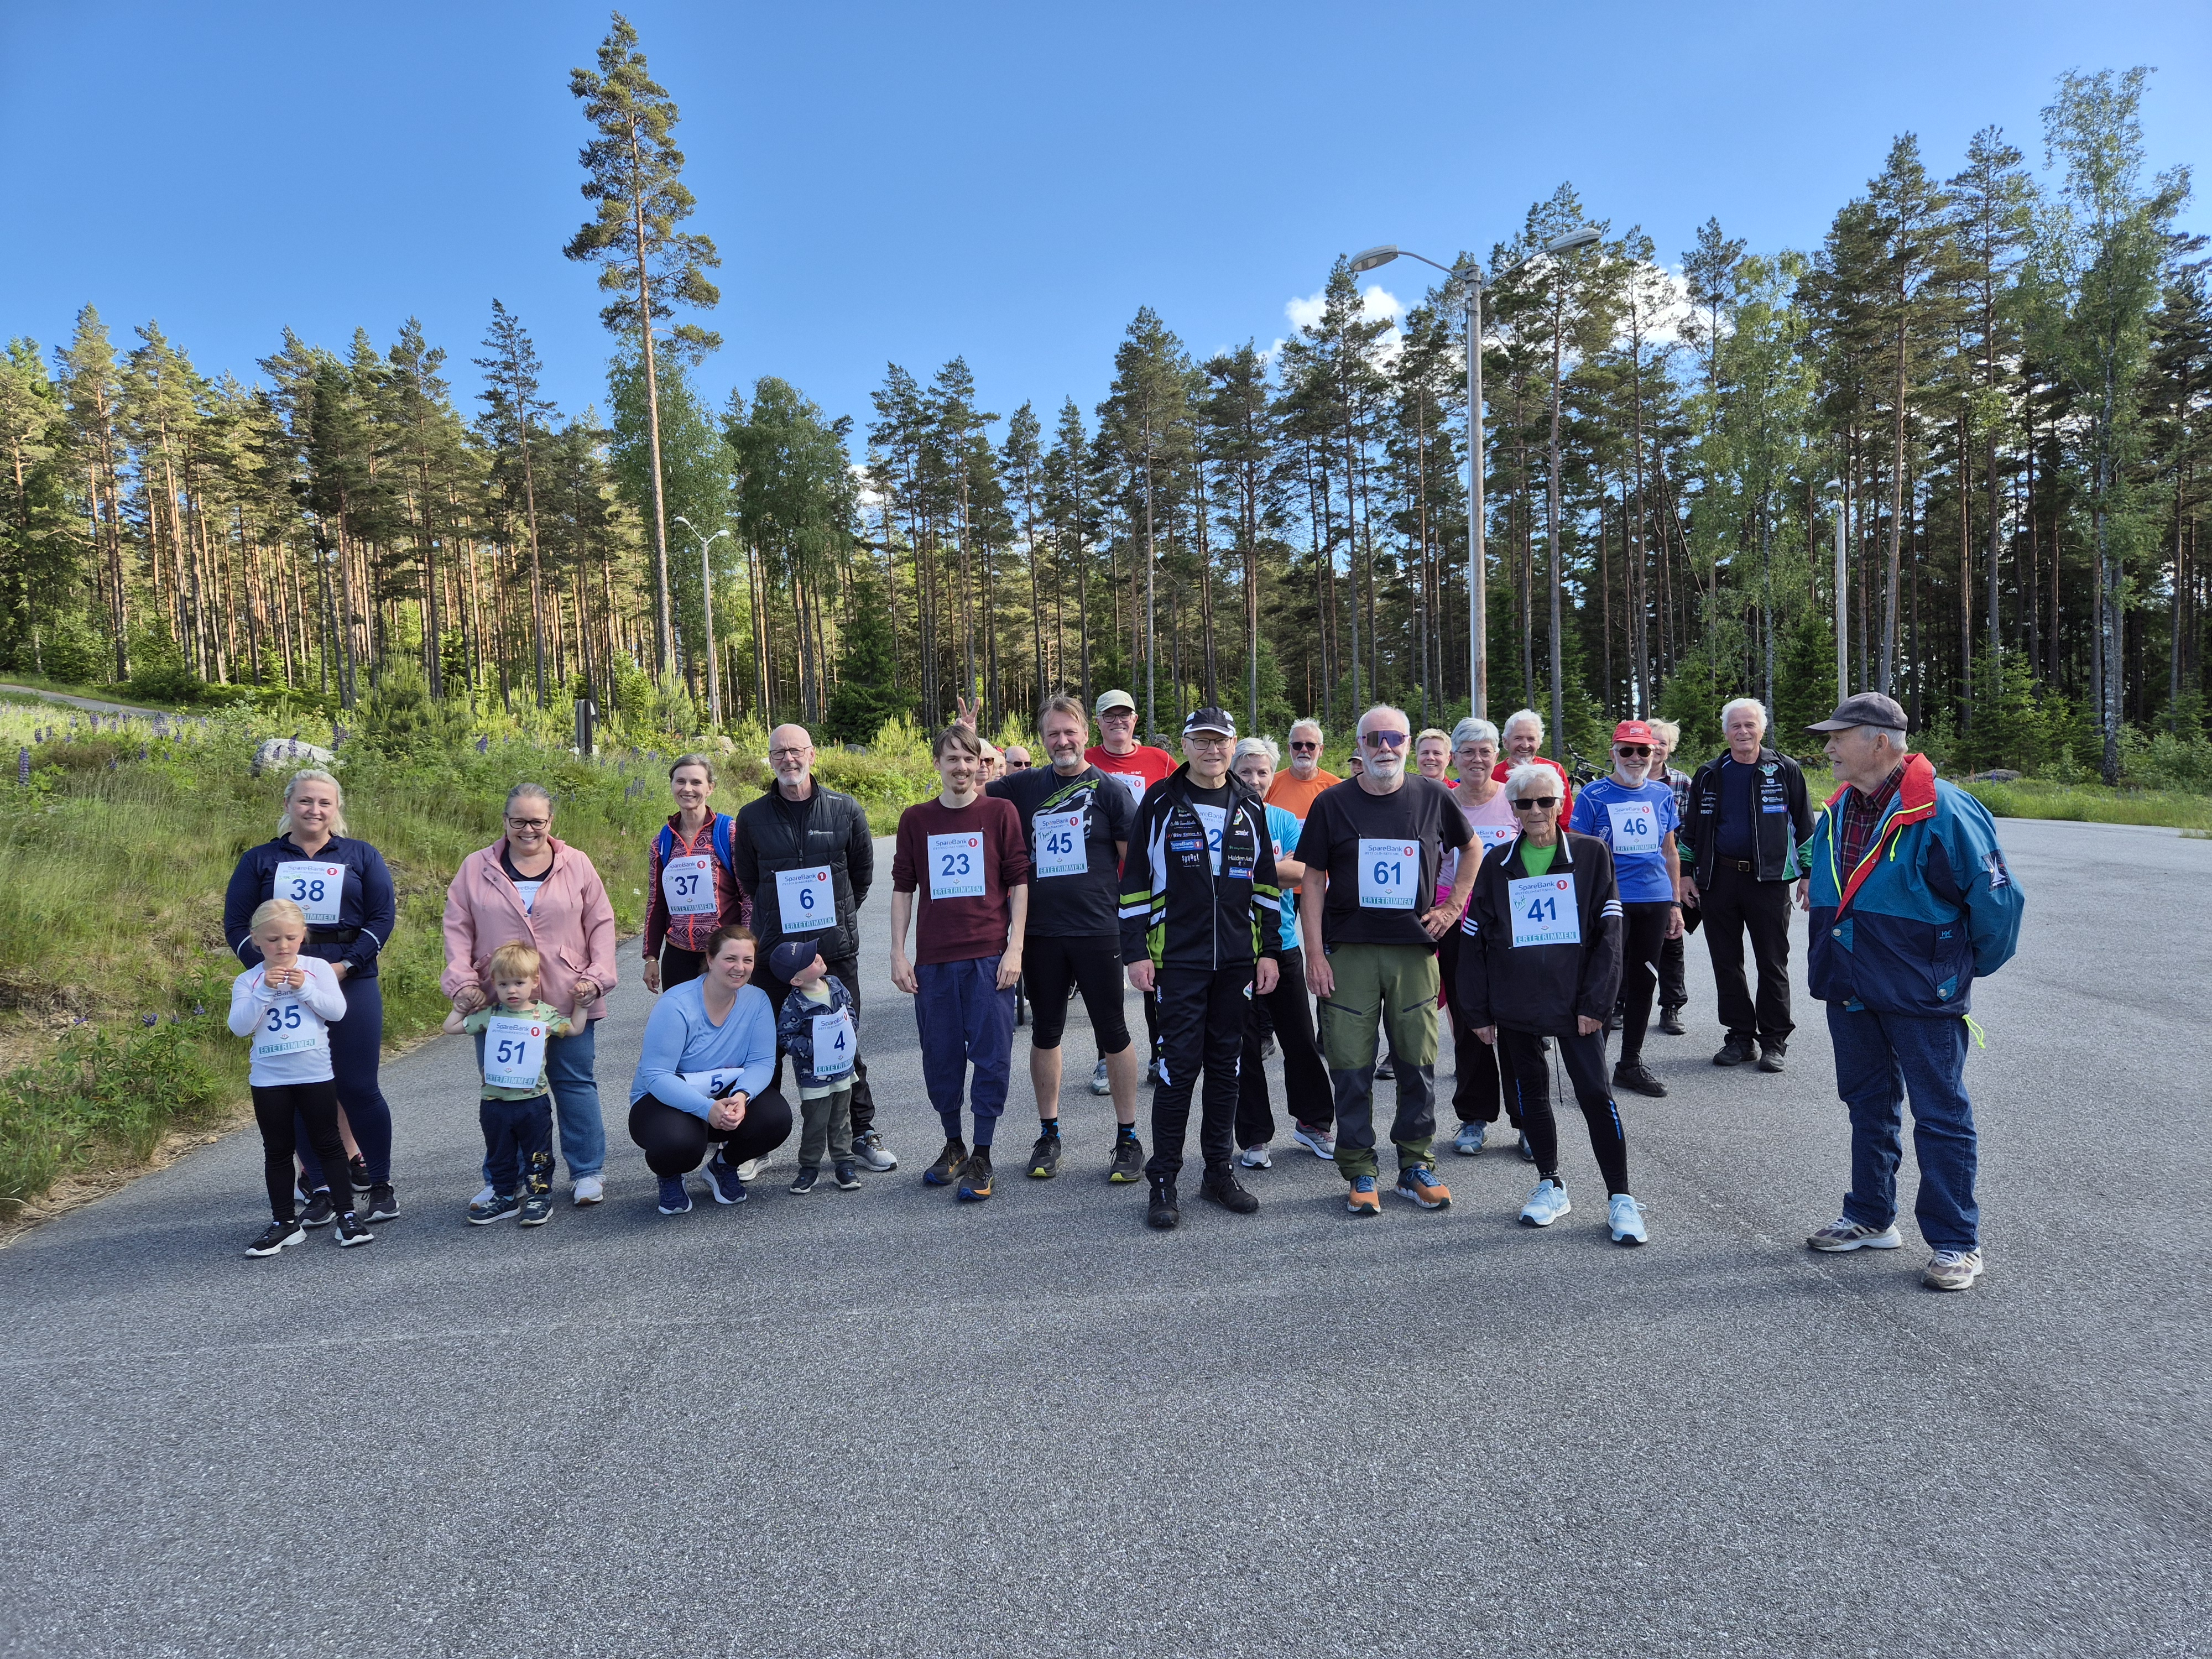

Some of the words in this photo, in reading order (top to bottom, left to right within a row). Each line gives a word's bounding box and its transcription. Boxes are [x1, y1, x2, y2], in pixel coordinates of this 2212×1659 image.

[1042, 818, 1069, 826] SpareBank
[1623, 818, 1647, 836] 46
[1047, 832, 1072, 854] 45
[1203, 827, 1223, 852] 2
[942, 853, 970, 877] 23
[1040, 864, 1083, 873] ERTETRIMMEN
[1374, 861, 1401, 885] 61
[675, 875, 698, 895] 37
[785, 873, 816, 882] SpareBank
[1519, 881, 1555, 891] SpareBank
[290, 878, 325, 902] 38
[800, 888, 814, 910] 6
[934, 886, 980, 895] ERTETRIMMEN
[672, 903, 713, 912] ERTETRIMMEN
[1364, 897, 1412, 905] ERTETRIMMEN
[1527, 897, 1556, 922] 41
[786, 917, 833, 929] ERTETRIMMEN
[1518, 932, 1574, 942] ERTETRIMMEN
[267, 1005, 301, 1032] 35
[497, 1023, 530, 1031] SpareBank
[260, 1040, 314, 1053] ERTETRIMMEN
[834, 1030, 846, 1051] 4
[497, 1040, 526, 1065] 51
[487, 1074, 534, 1084] ERTETRIMMEN
[709, 1073, 724, 1094] 5
